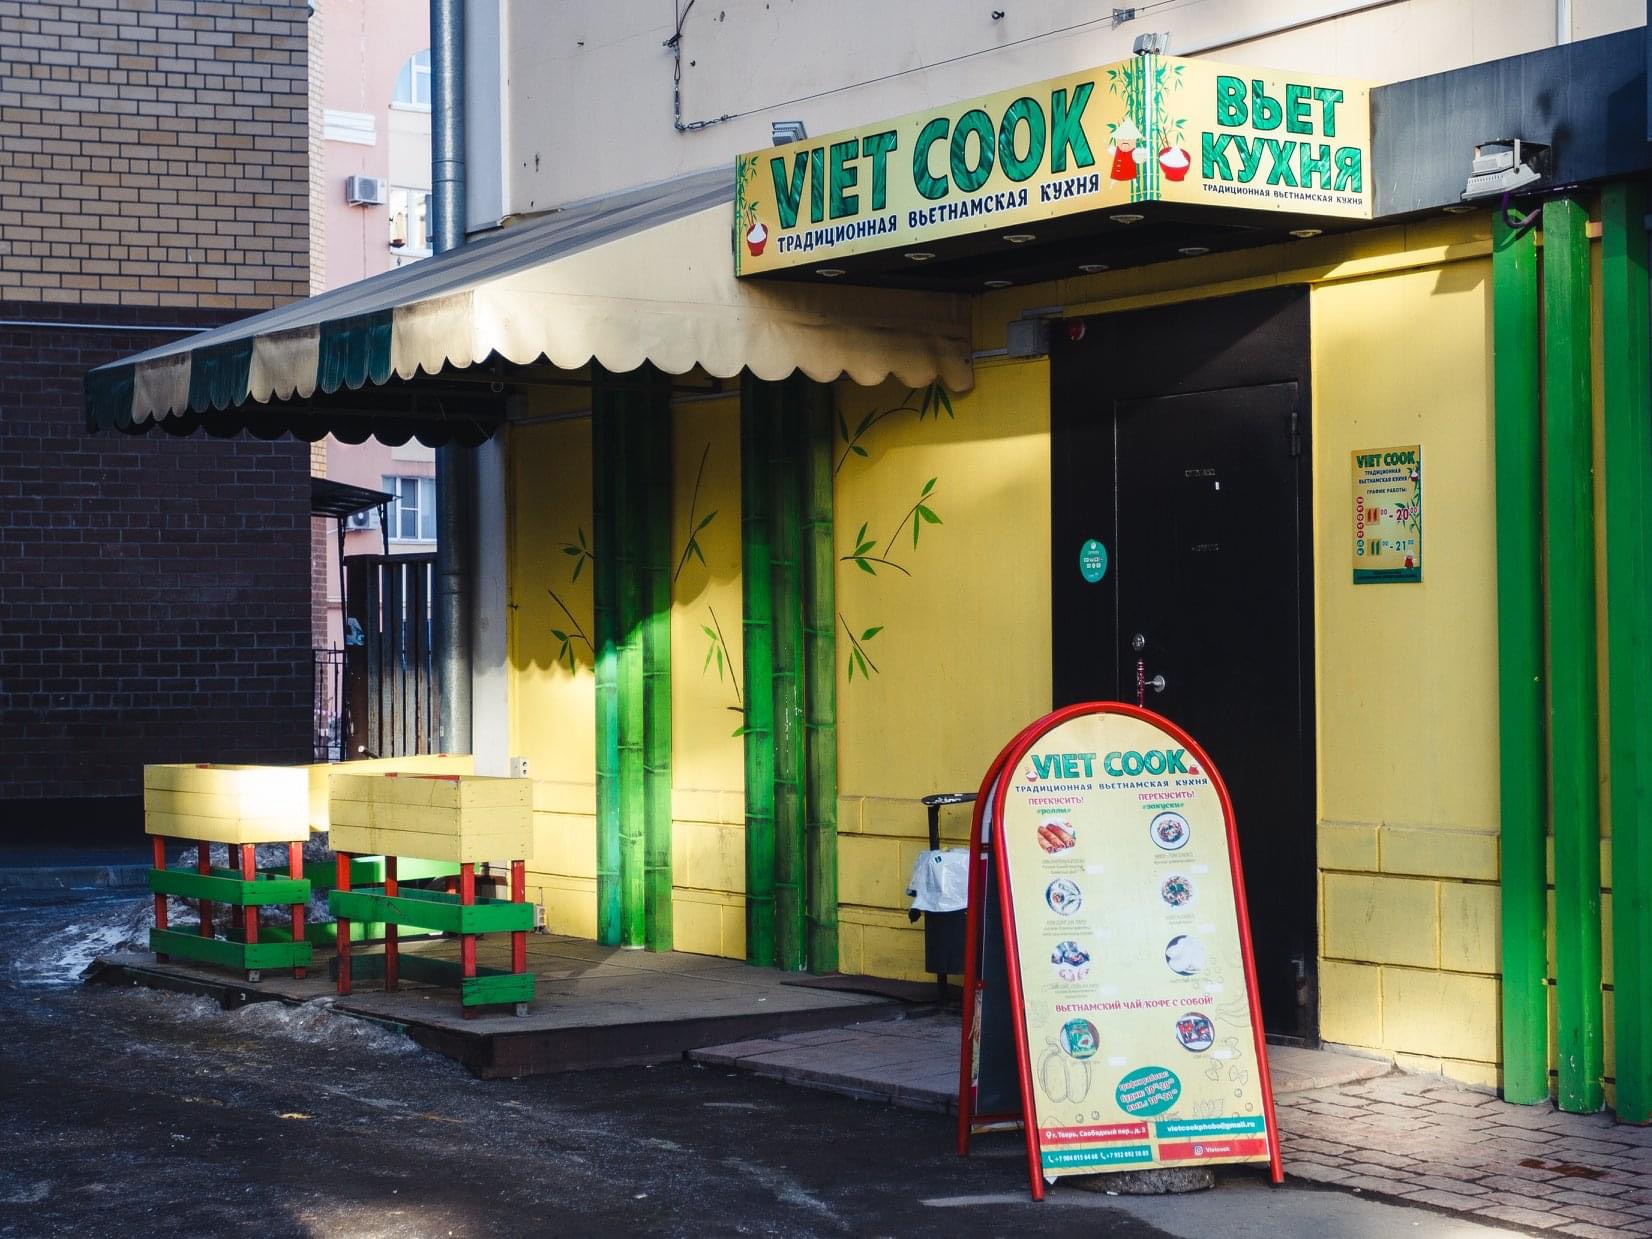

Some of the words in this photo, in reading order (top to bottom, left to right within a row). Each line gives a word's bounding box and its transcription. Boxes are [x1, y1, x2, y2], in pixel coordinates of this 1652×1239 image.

[1216, 75, 1343, 137] ВЬЕТ
[770, 130, 897, 229] VIET
[912, 82, 1095, 200] COOK
[1201, 132, 1362, 193] КУХНЯ
[1202, 183, 1270, 197] ТРАДИЦИОННАЯ
[1273, 190, 1333, 203] ВЬЕТНАМСКАЯ
[1336, 196, 1363, 205] КУХНЯ
[778, 214, 897, 252] ТРАДИЦИОННАЯ
[908, 188, 1029, 228] ВЬЕТНАМСКАЯ
[1040, 174, 1100, 202] КУХНЯ
[1356, 454, 1381, 468] VIET
[1384, 451, 1415, 466] COOK
[1032, 753, 1096, 779] VIET
[1104, 749, 1187, 776] COOK
[1016, 784, 1092, 793] ТРАДИЦИОННАЯ
[1099, 780, 1169, 790] ВЬЕТНАМСКАЯ
[1175, 778, 1208, 786] КУХНЯ
[1028, 796, 1084, 806] ПЕРЕКУСИТЬ!
[1138, 791, 1195, 801] ПЕРЕКУСИТЬ!
[1055, 1000, 1121, 1012] ВЬЕТНАМСКИЙ
[1181, 996, 1213, 1006] СОБОЙ!
[1079, 1129, 1116, 1137] Свободный
